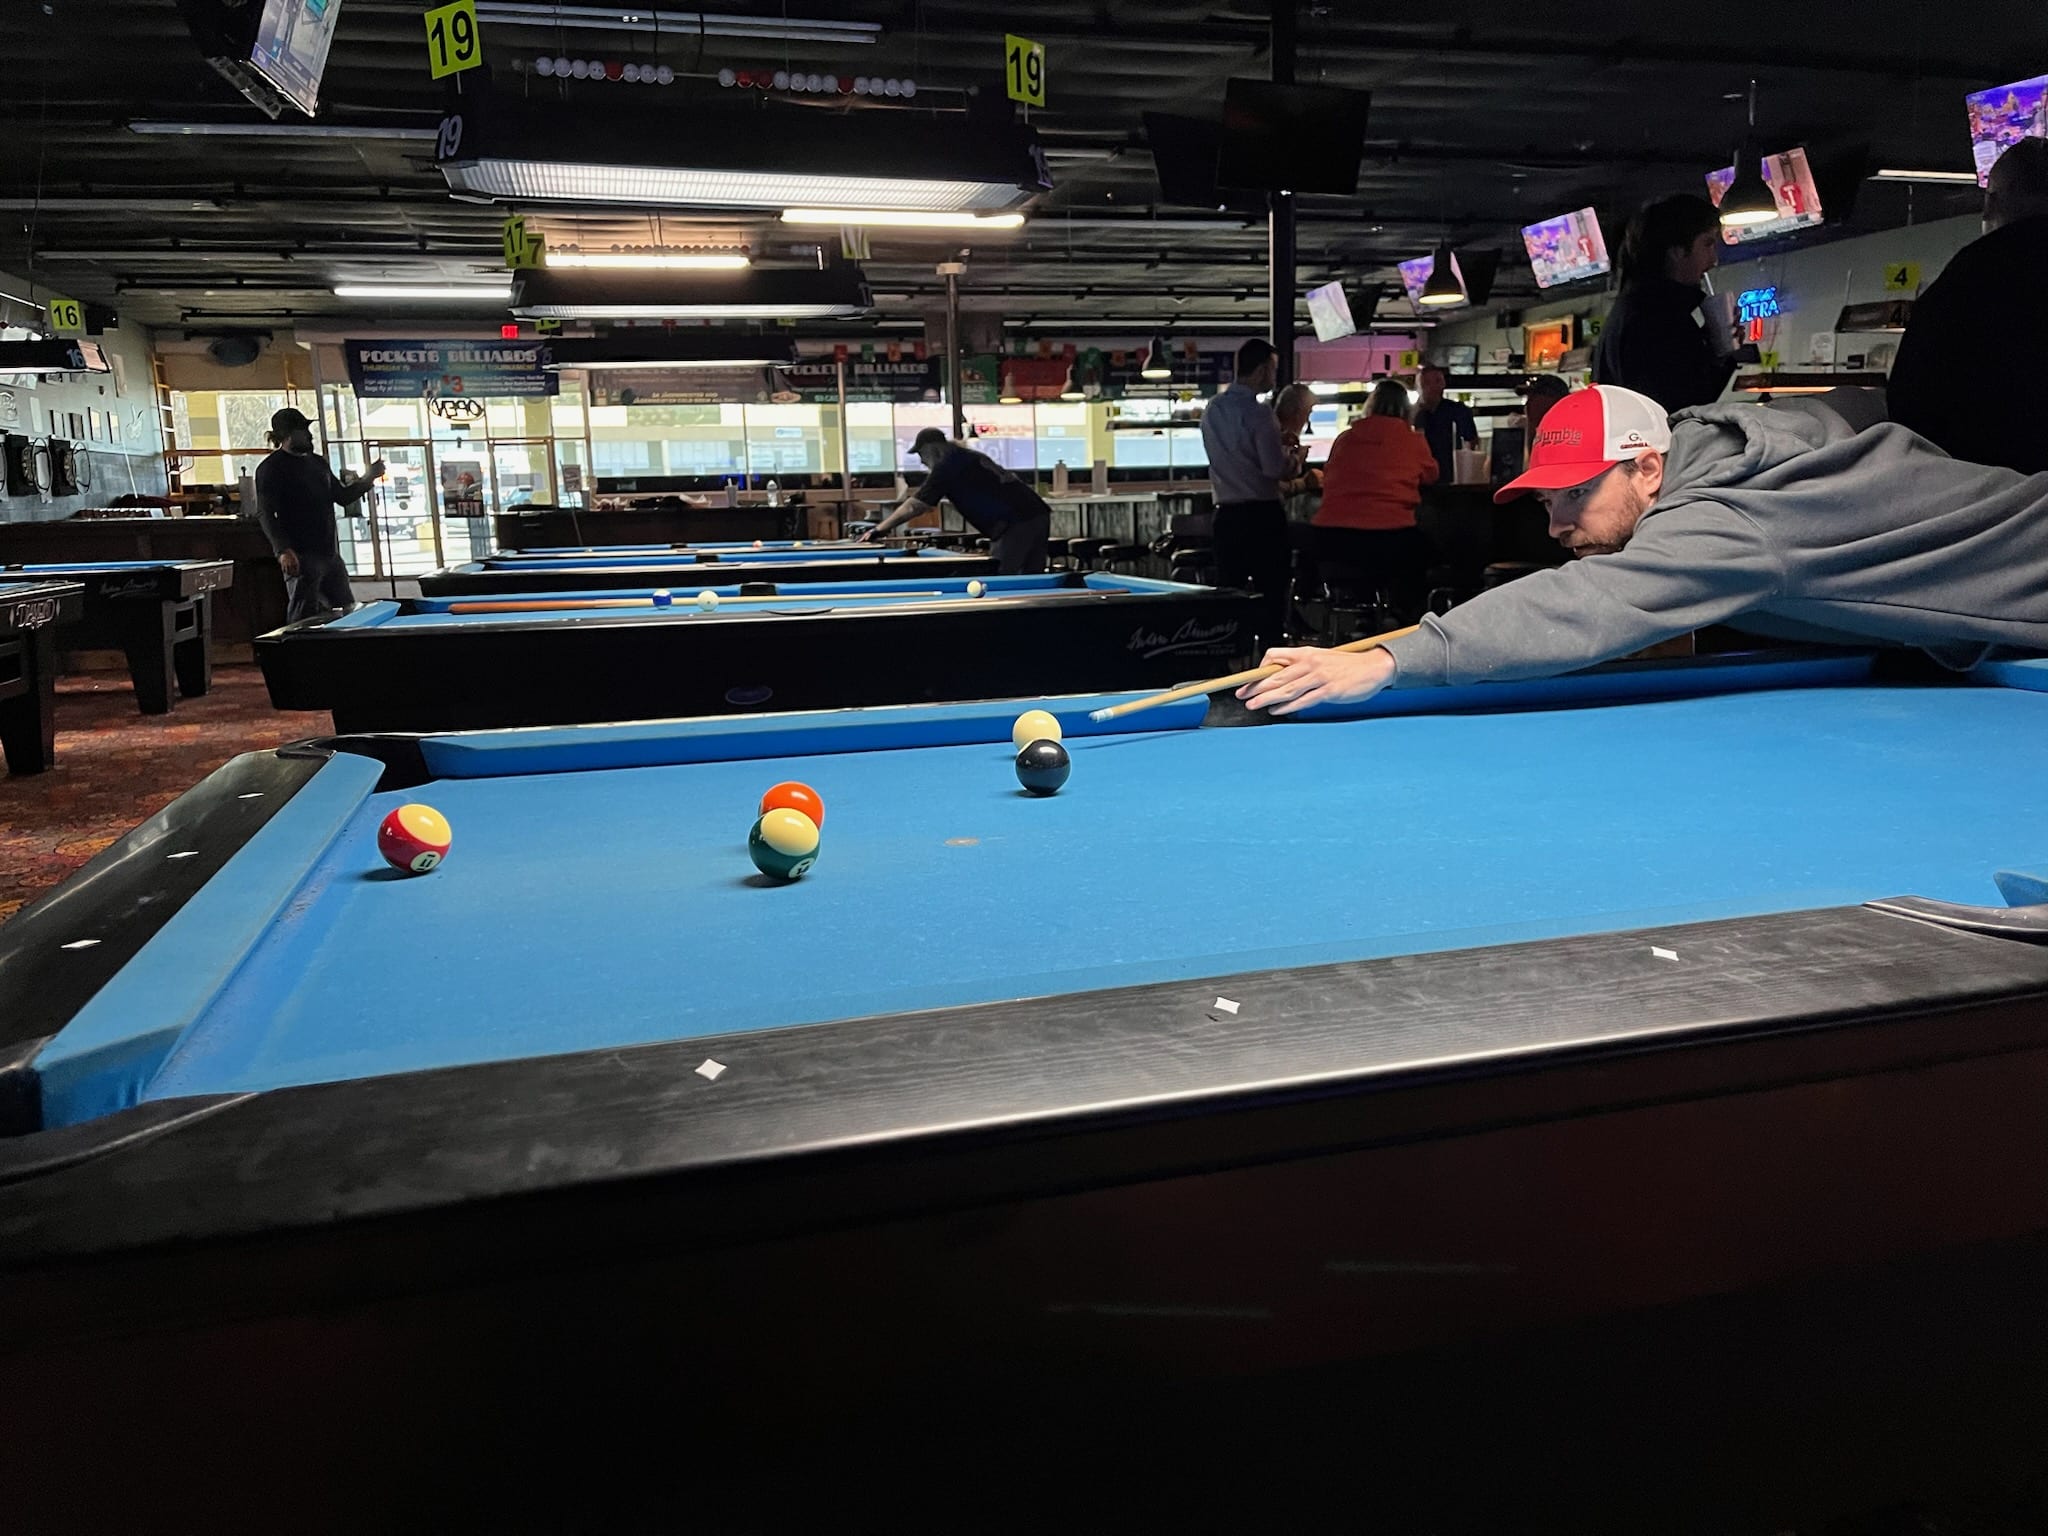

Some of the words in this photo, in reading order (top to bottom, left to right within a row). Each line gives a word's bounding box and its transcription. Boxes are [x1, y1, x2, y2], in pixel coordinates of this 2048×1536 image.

[430, 10, 475, 67] 19
[1009, 46, 1041, 97] 19
[437, 114, 463, 160] 19
[506, 221, 525, 255] 17
[1893, 266, 1909, 287] 4
[53, 304, 79, 327] 16
[360, 349, 440, 364] POCKETS
[447, 349, 537, 363] BILLIARDS
